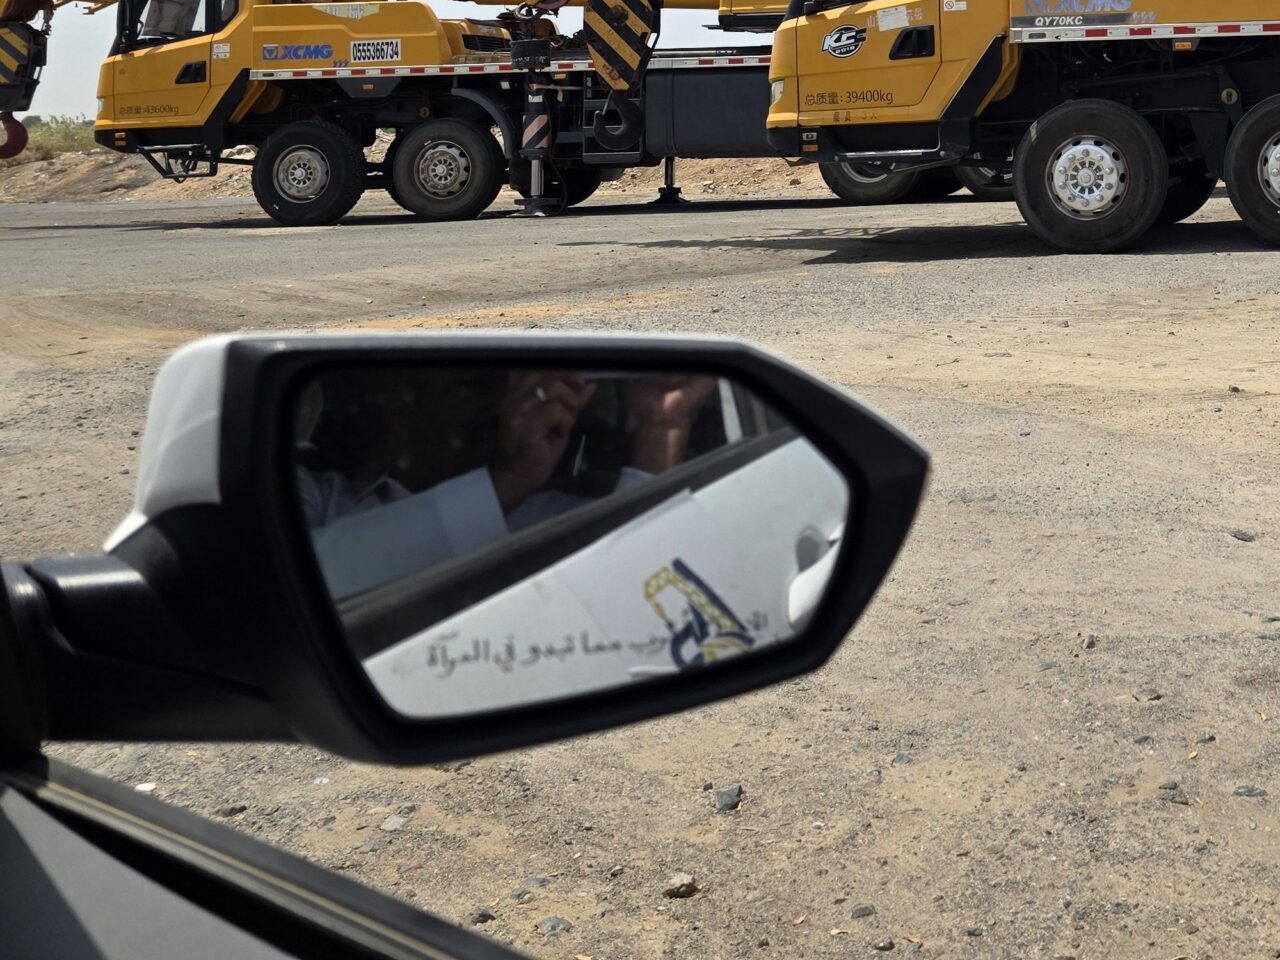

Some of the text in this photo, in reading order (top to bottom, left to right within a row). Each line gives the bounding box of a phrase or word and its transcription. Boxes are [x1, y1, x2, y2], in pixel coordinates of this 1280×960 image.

[1035, 16, 1083, 26] QY70KC
[278, 44, 334, 60] XCMG
[352, 41, 400, 61] 0555366734
